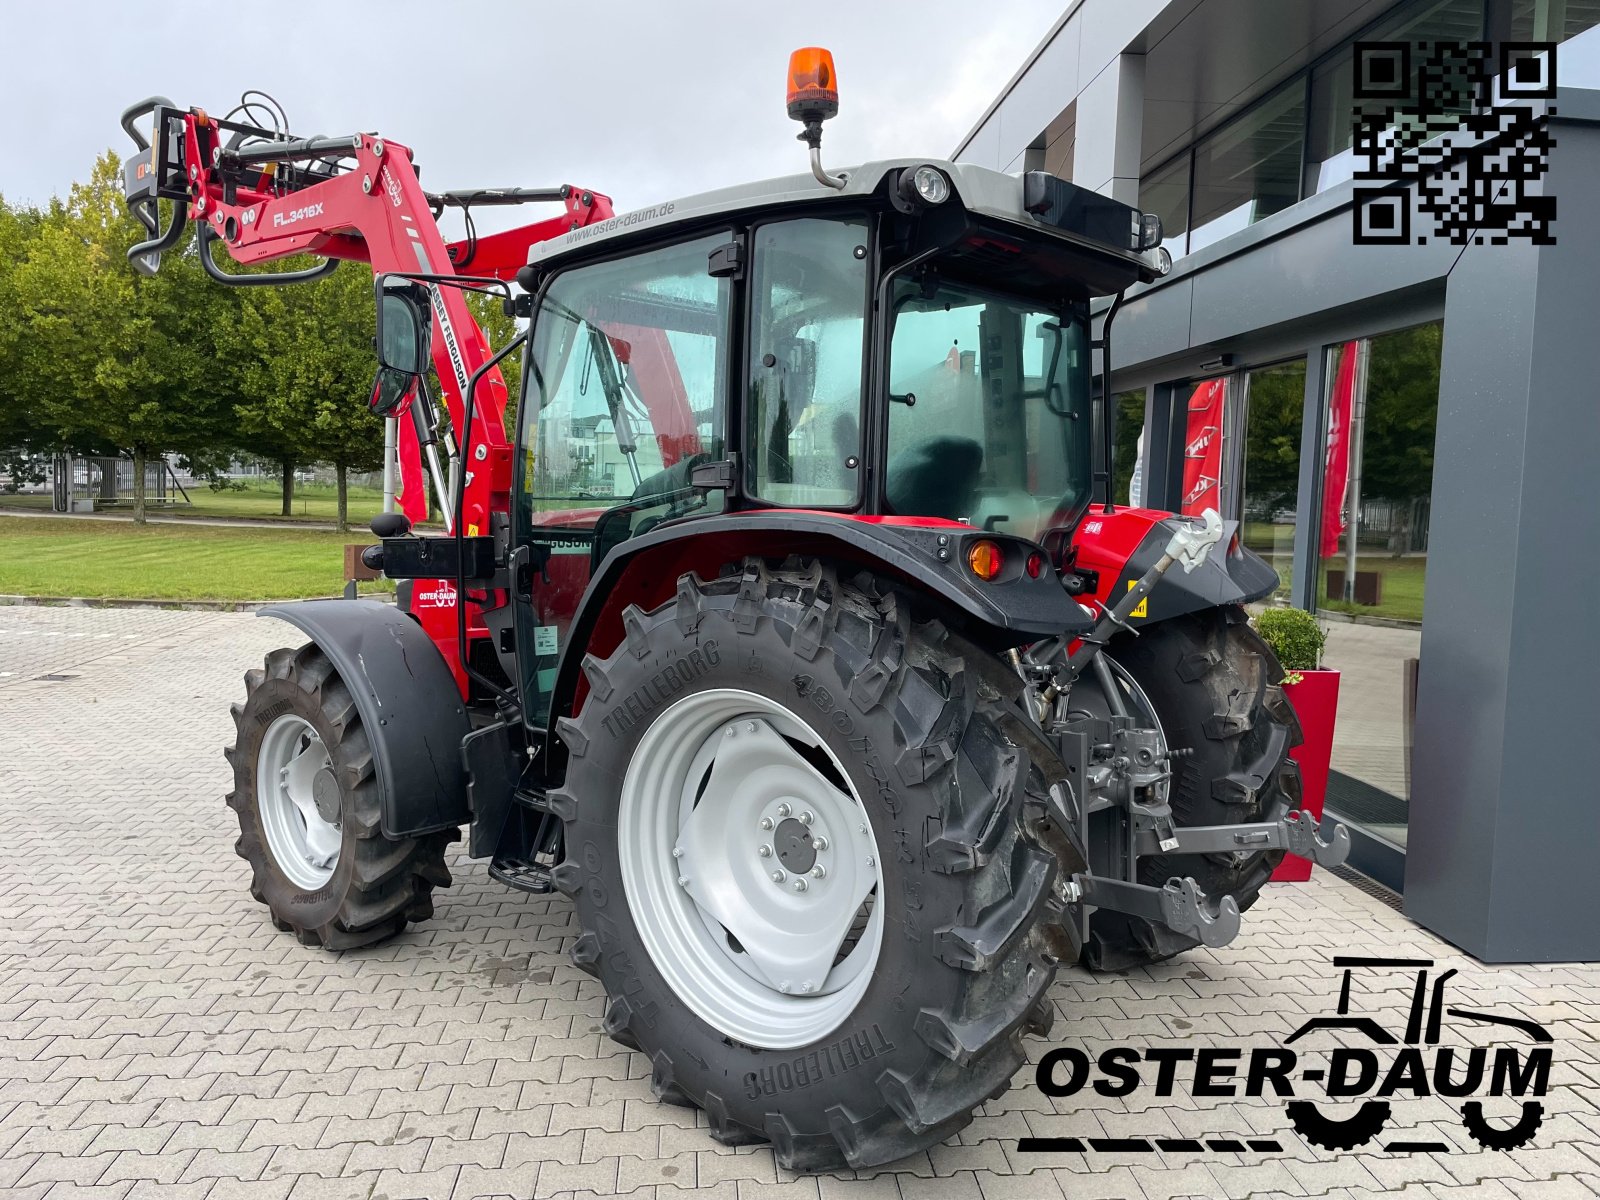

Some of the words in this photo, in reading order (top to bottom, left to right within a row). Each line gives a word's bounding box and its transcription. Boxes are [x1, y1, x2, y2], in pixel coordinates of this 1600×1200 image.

[273, 202, 324, 228] FL.3416X
[566, 203, 675, 244] www.oster-daum.de
[444, 325, 467, 390] FERGUSON
[419, 592, 457, 600] OSTER-DAUM
[601, 639, 721, 738] TRELLEBORG
[743, 1023, 896, 1101] TRELLEBORG
